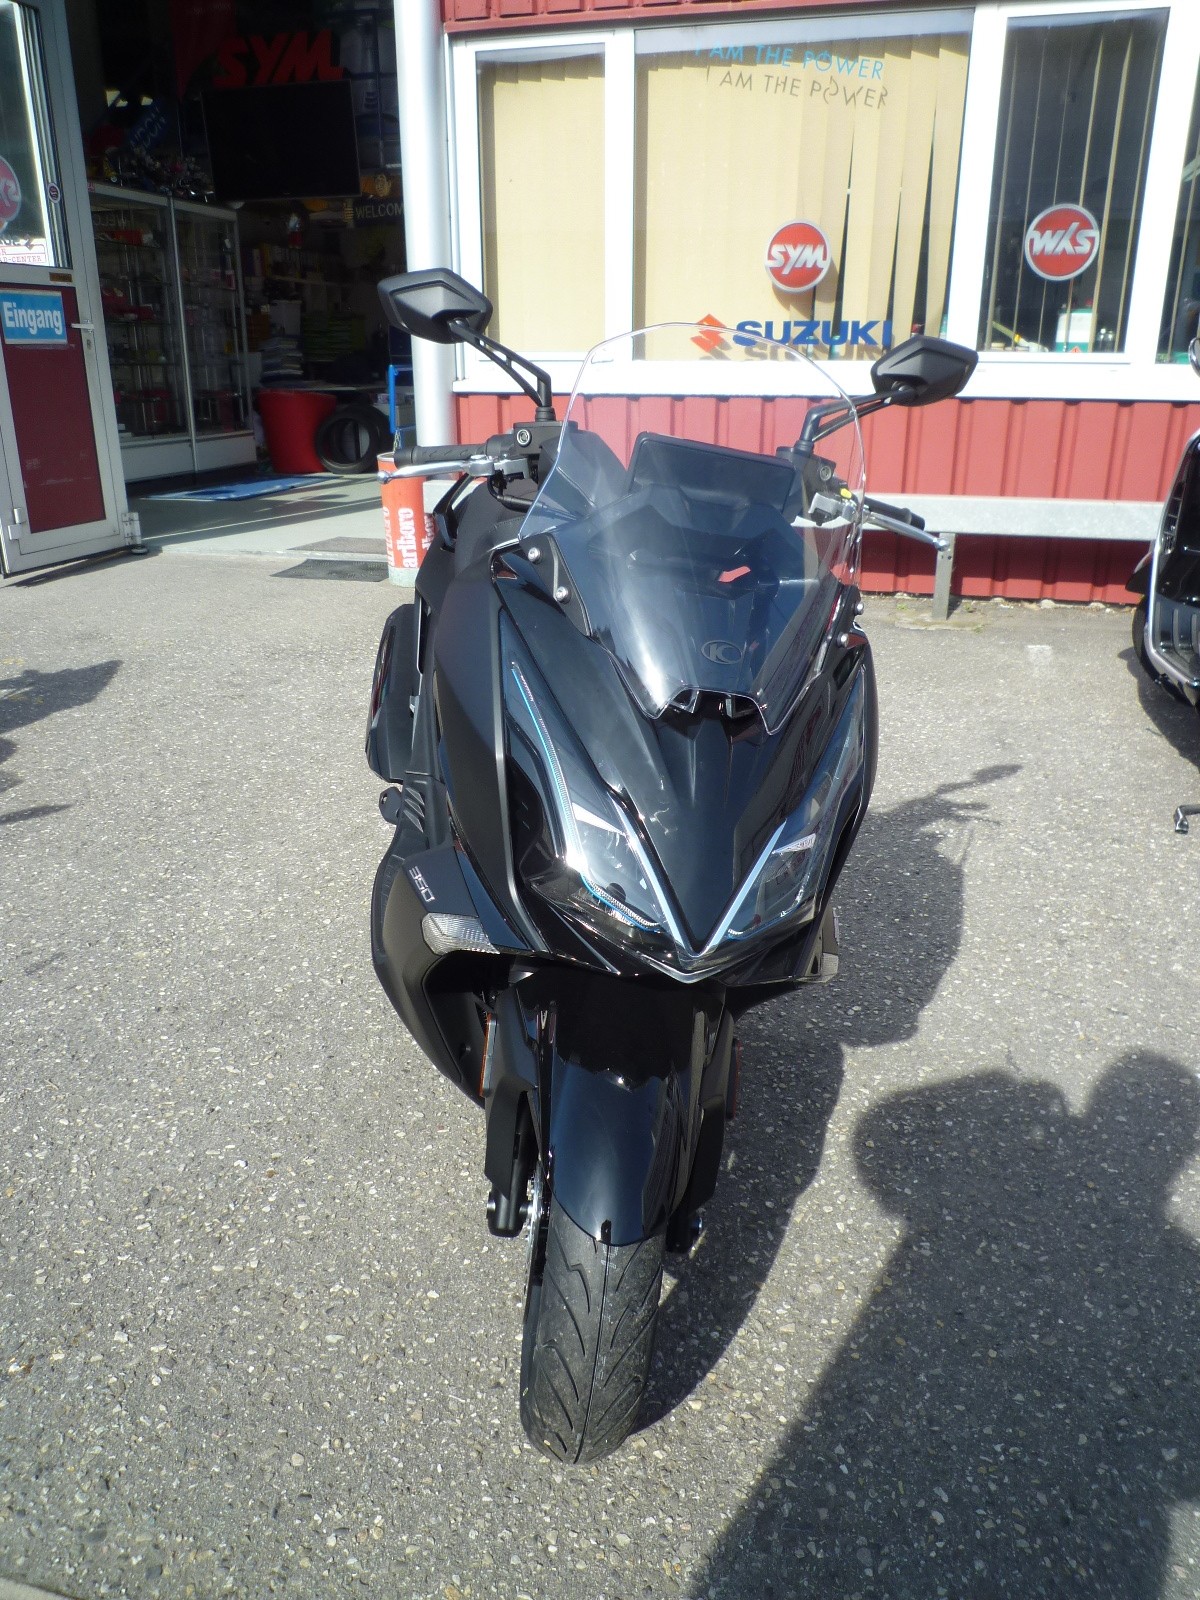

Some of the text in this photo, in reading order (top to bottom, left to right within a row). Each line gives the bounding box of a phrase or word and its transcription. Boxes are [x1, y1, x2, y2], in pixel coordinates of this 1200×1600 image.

[212, 29, 346, 88] SYM
[709, 42, 745, 63] AM
[754, 45, 793, 67] THE
[803, 50, 884, 80] POWER
[766, 243, 825, 275] SYM
[4, 301, 63, 336] Eingang
[732, 319, 893, 347] SUZUKI
[408, 865, 436, 903] 350
